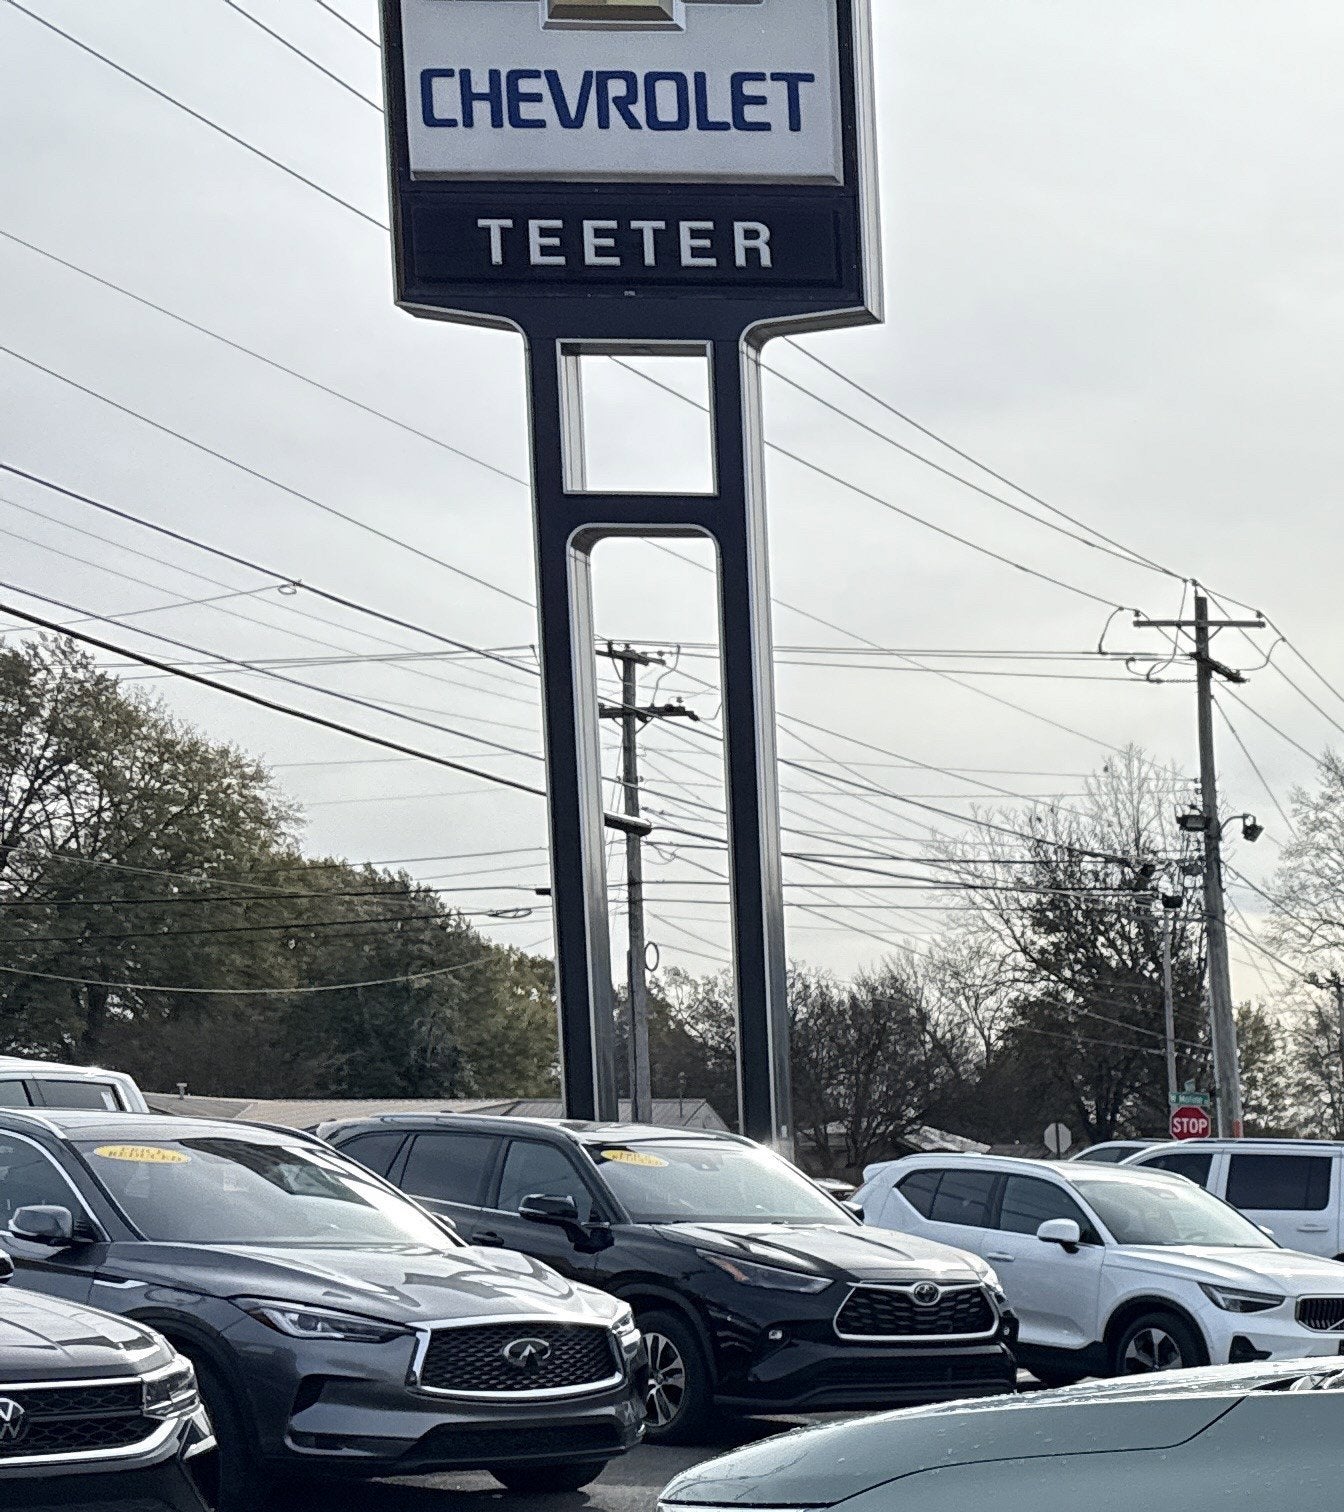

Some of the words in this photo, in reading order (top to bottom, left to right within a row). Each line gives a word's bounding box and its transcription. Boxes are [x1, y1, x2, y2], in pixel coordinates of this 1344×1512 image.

[420, 68, 815, 131] CHEVROLET
[477, 218, 774, 268] TEETER
[1172, 1116, 1208, 1134] STOP
